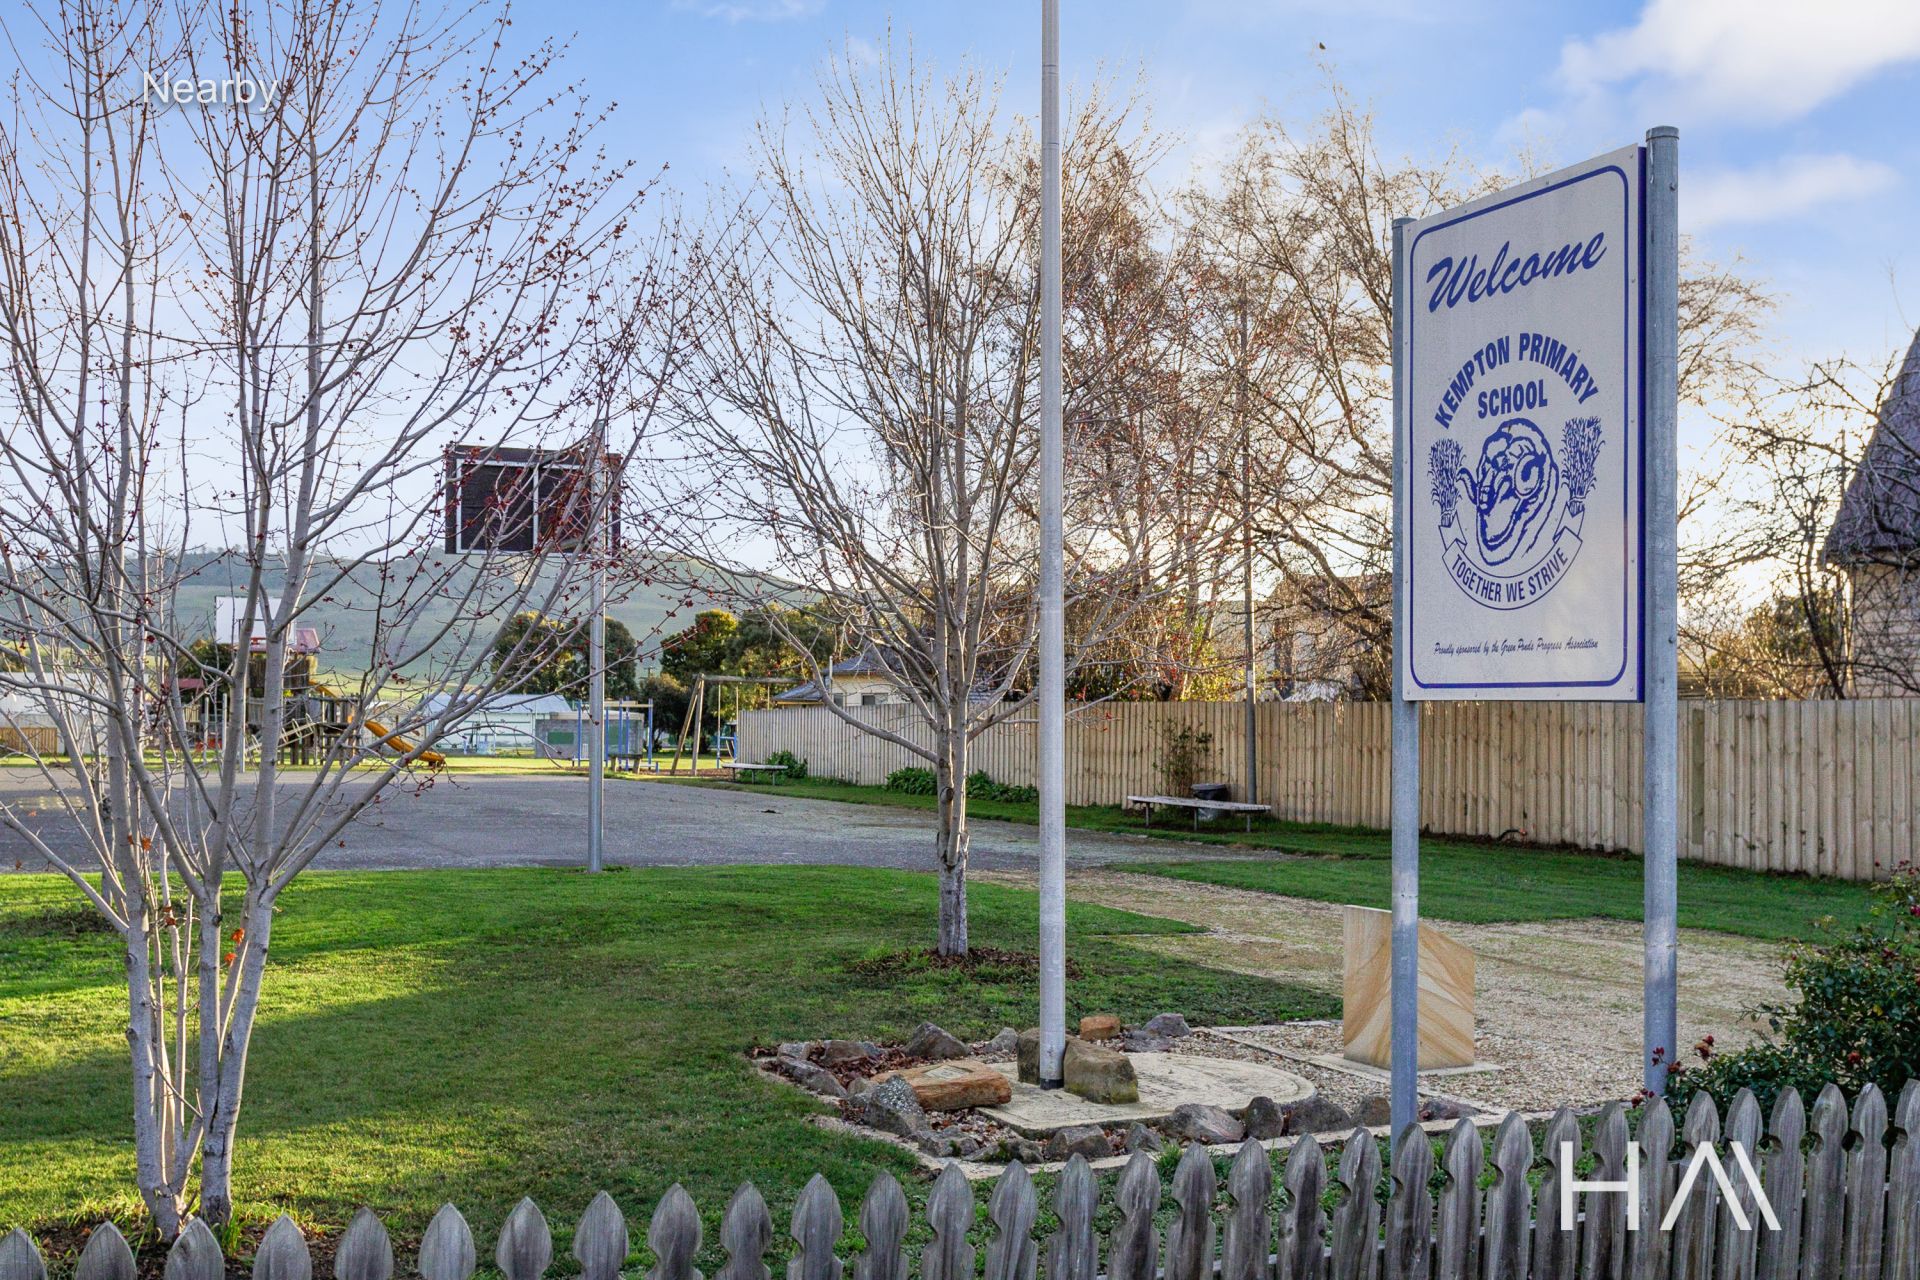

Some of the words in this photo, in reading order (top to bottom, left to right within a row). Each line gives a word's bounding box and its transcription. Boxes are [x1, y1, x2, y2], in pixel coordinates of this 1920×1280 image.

[1426, 231, 1607, 313] Welcome
[1434, 335, 1510, 430] KEMPTON
[1518, 332, 1599, 405] PRIMARY
[1477, 378, 1548, 420] SCHOOL
[1451, 554, 1502, 602] TOGETHER
[1506, 581, 1526, 602] WE
[1528, 547, 1569, 595] STRIVE
[1434, 642, 1454, 656] Proudly
[1456, 641, 1480, 655] sponsored
[1483, 640, 1489, 656] by
[1500, 639, 1516, 655] Green
[1536, 637, 1562, 654] Progress
[1565, 636, 1598, 650] Association
